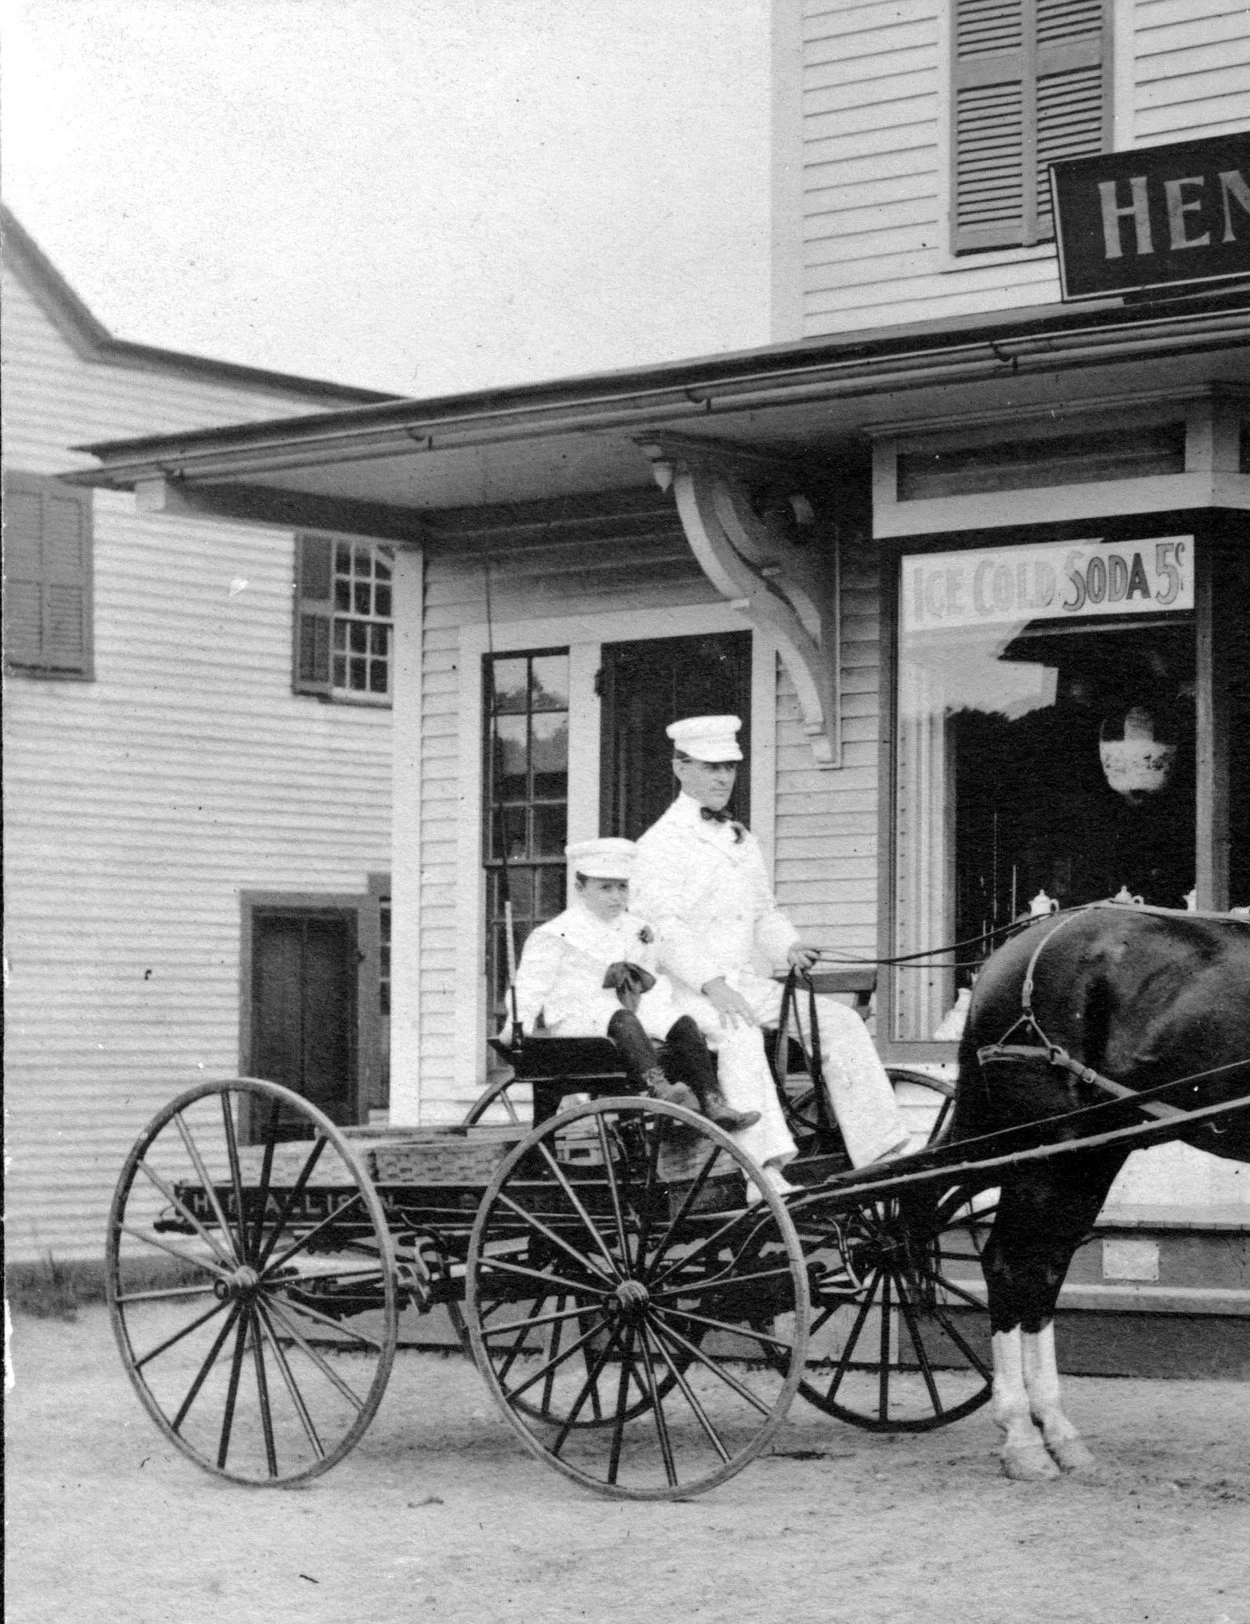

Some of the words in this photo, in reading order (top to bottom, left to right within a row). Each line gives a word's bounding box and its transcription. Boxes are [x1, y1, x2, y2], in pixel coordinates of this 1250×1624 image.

[913, 566, 965, 622] ICE
[972, 558, 1057, 617] COLD
[1062, 550, 1151, 612] SODA
